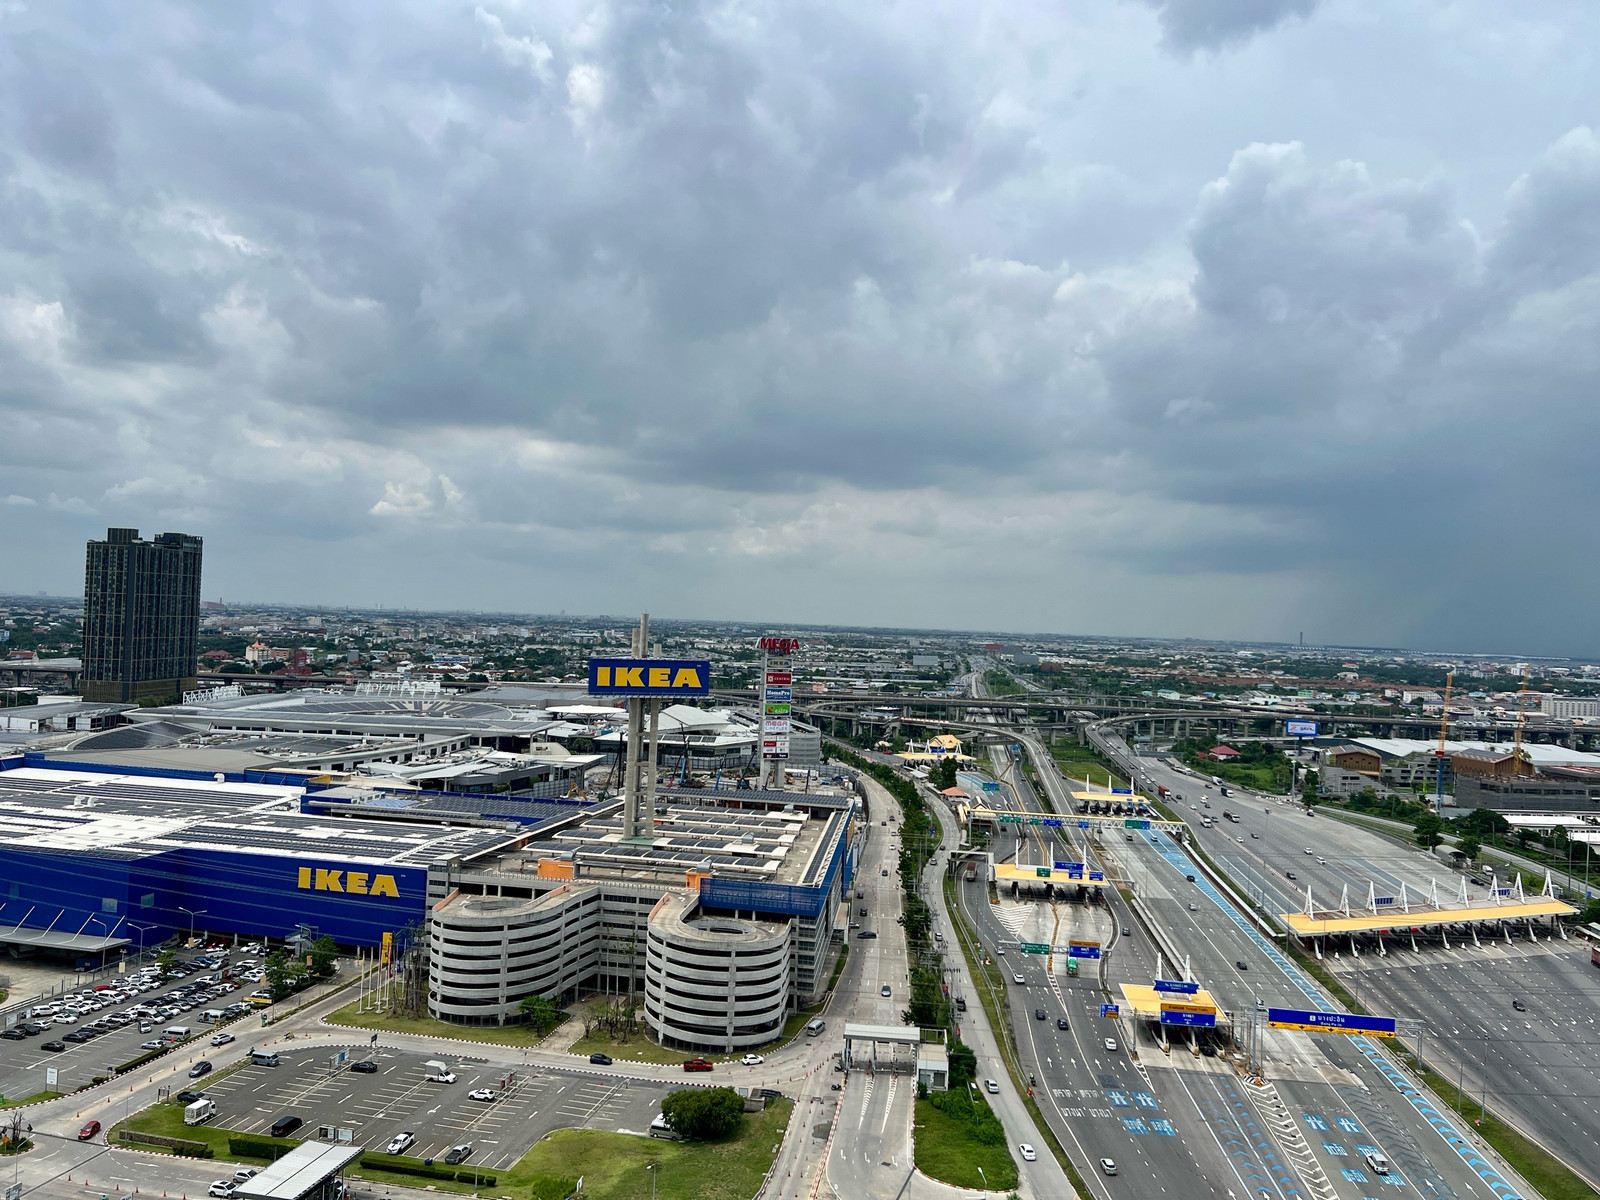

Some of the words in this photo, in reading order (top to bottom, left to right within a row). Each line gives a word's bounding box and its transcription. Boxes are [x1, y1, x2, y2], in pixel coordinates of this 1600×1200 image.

[760, 637, 799, 654] MEGA
[596, 666, 702, 688] IKEA
[297, 866, 400, 898] IKEA
